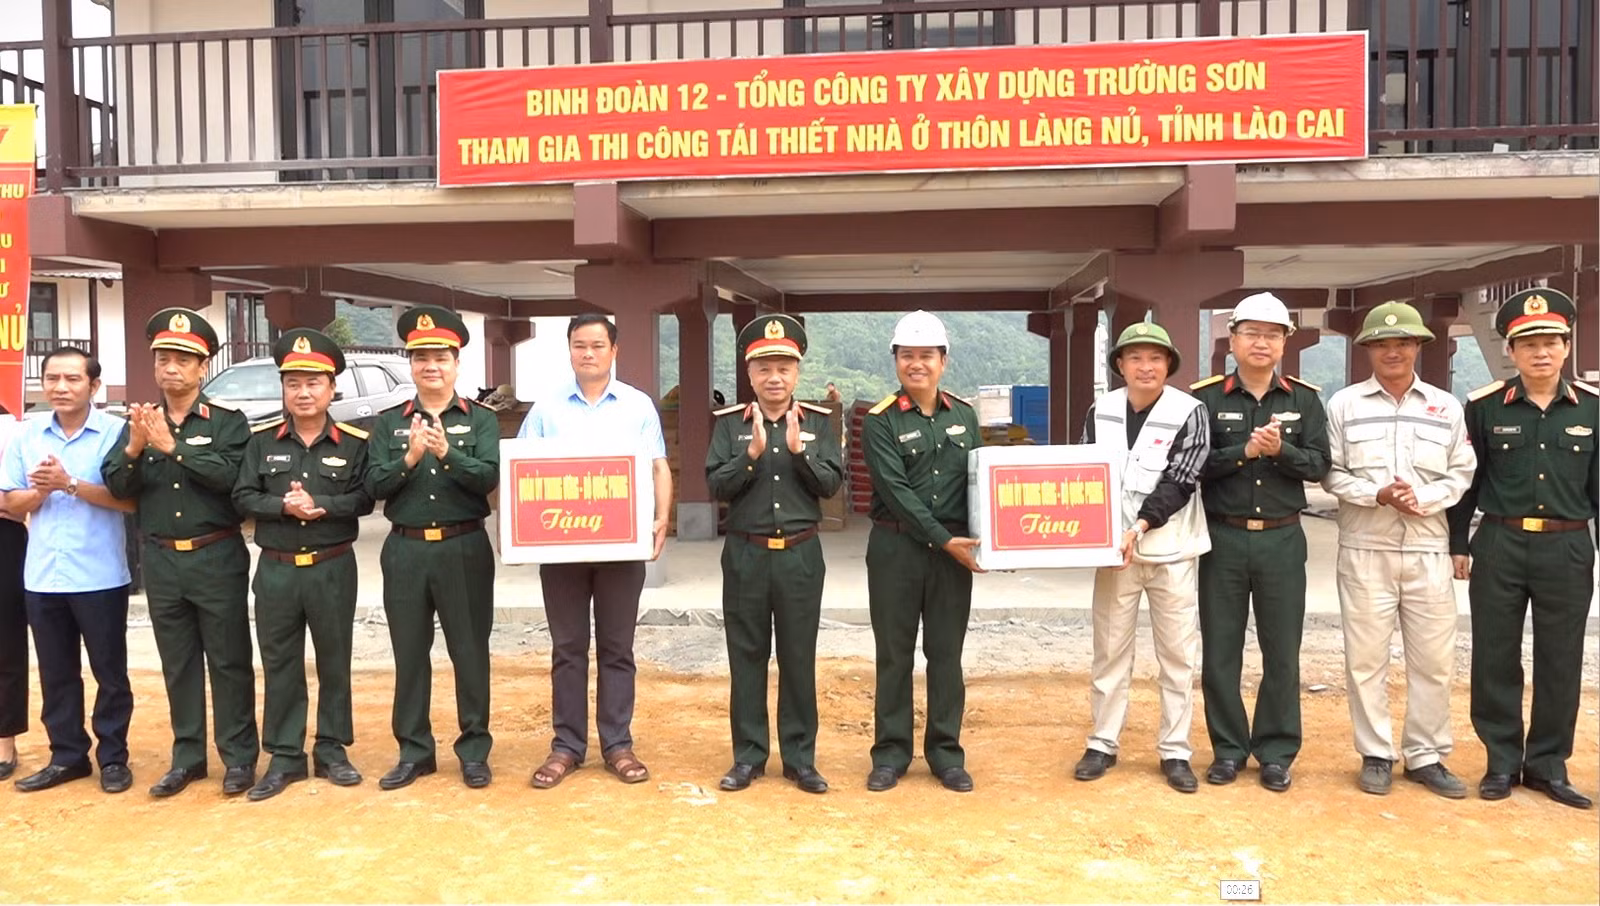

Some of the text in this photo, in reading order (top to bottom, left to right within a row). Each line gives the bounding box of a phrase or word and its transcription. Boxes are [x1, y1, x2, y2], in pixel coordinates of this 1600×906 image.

[526, 87, 589, 116] BINH
[596, 79, 669, 113] ĐOÀN
[678, 82, 709, 110] 12
[734, 69, 805, 108] TỔNG
[814, 71, 888, 106] CÔNG
[896, 73, 928, 102] TY
[936, 67, 989, 101] XÂY
[998, 67, 1075, 105] DỰNG
[1084, 58, 1197, 97] TRƯỜNG
[1206, 59, 1266, 92] SƠN
[458, 104, 1345, 166] THAM GIA THI CÔNG TÁI THIẾT NHÀ Ở THÔN LÀNG NỦ, TỈNH LÀO CAI
[540, 508, 604, 534] Tặng
[1020, 513, 1081, 539] Tặng
